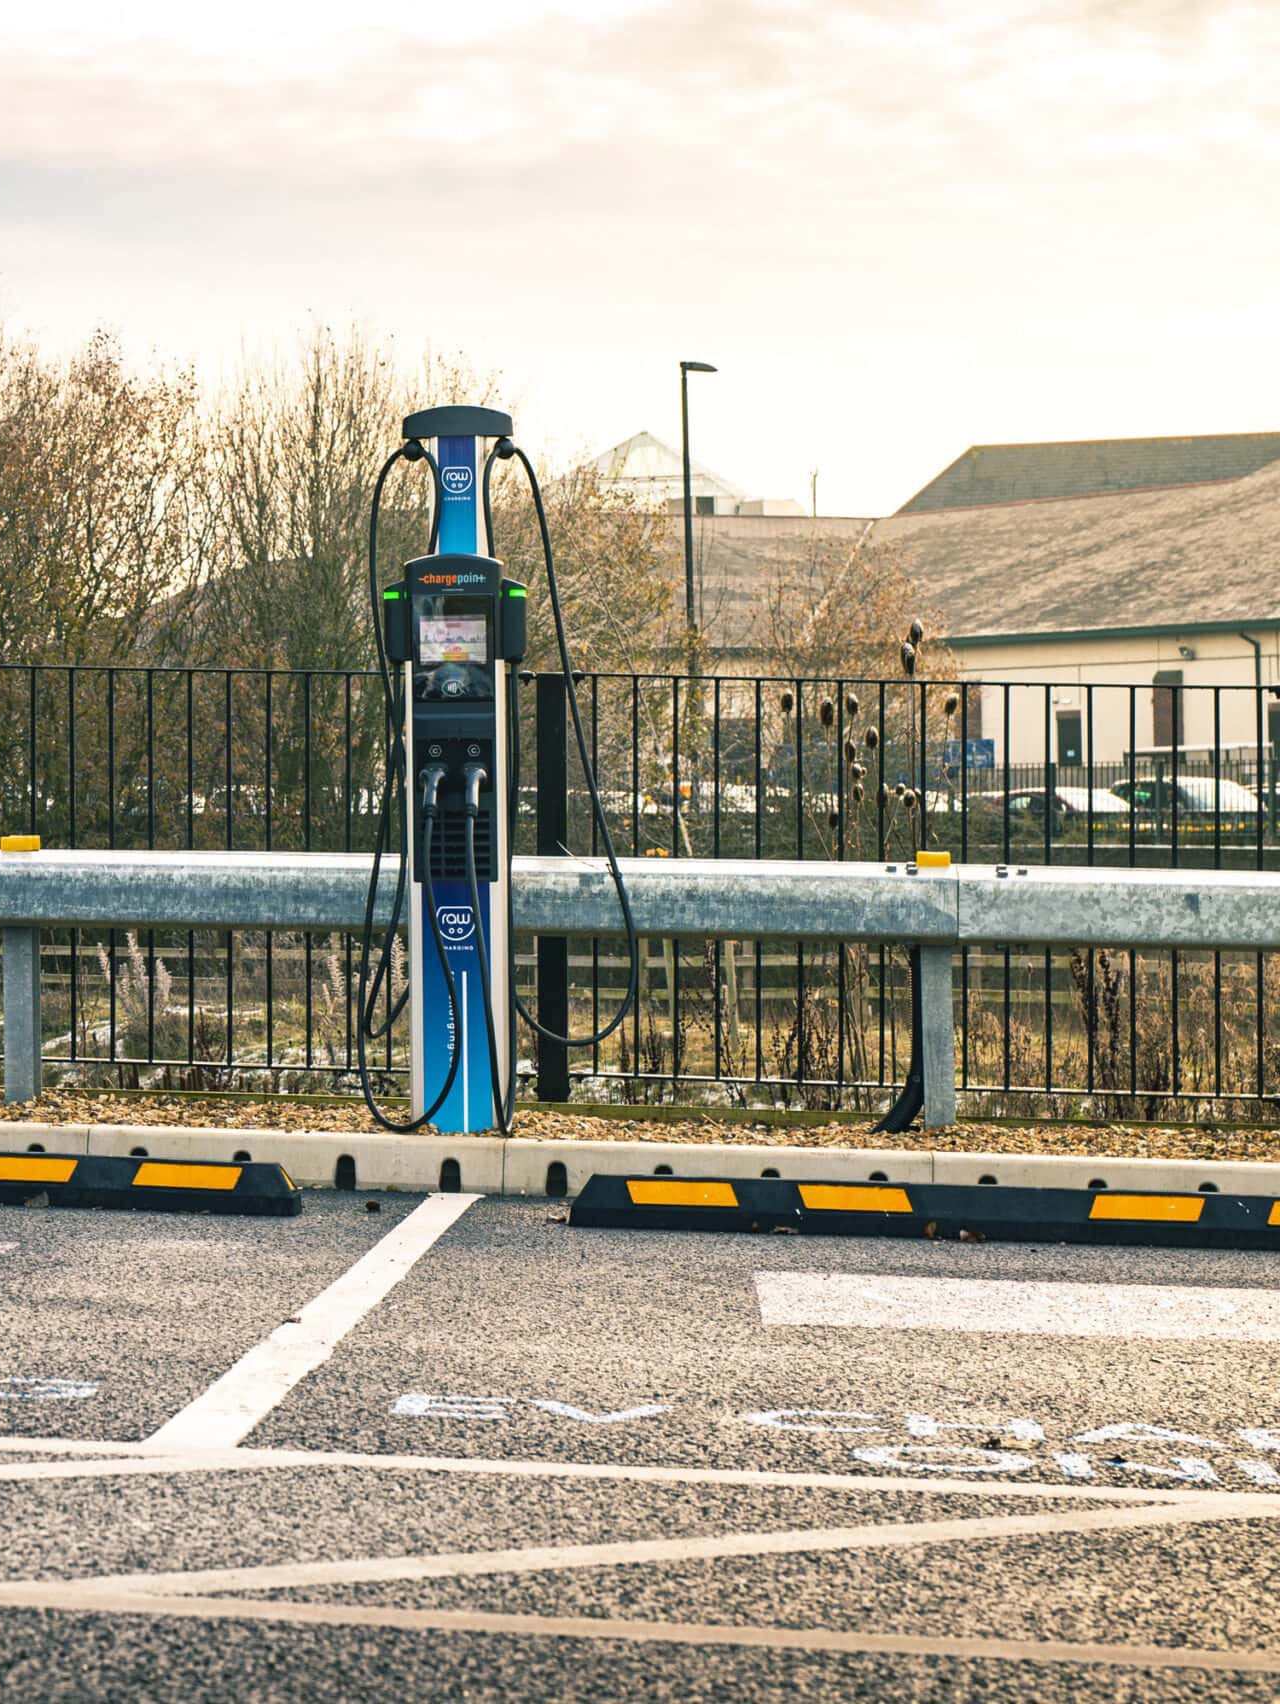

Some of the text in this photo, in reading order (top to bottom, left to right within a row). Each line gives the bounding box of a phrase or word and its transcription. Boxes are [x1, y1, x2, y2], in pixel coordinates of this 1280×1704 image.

[446, 472, 468, 481] raw
[419, 572, 486, 587] chargepoint
[442, 913, 470, 925] raw
[390, 1393, 675, 1424] EV
